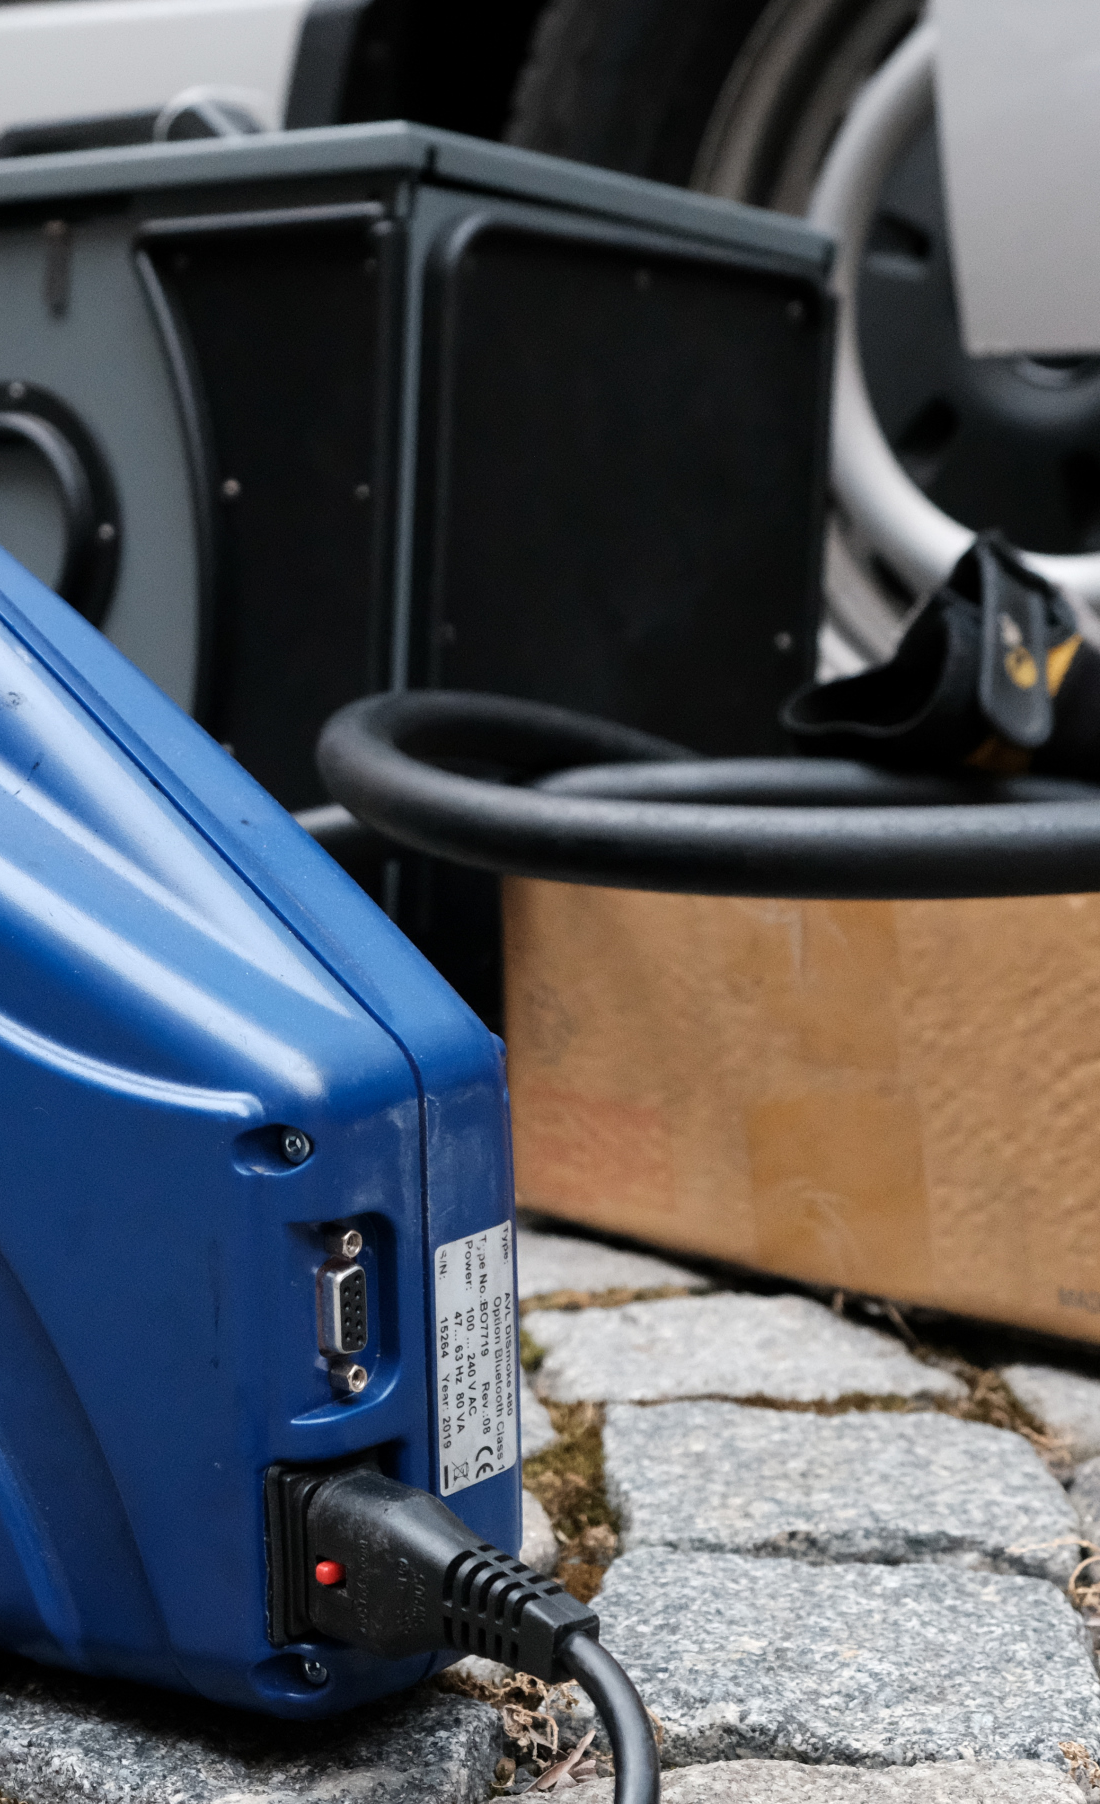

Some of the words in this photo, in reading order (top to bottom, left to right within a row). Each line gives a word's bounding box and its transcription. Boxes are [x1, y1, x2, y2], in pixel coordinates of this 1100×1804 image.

[465, 1240, 473, 1291] Power:
[466, 1307, 474, 1332] 100
[492, 1296, 502, 1344] Option
[440, 1317, 449, 1359] 15264
[455, 1345, 463, 1362] 63
[467, 1353, 476, 1378] 240
[455, 1365, 464, 1385] Hz
[468, 1381, 476, 1390] V
[495, 1348, 504, 1418] Bluetooth
[441, 1374, 450, 1411] Year:
[456, 1392, 465, 1409] 80
[468, 1397, 477, 1417] AC
[442, 1416, 451, 1449] 2019
[456, 1411, 465, 1434] VA
[496, 1421, 504, 1460] Class
